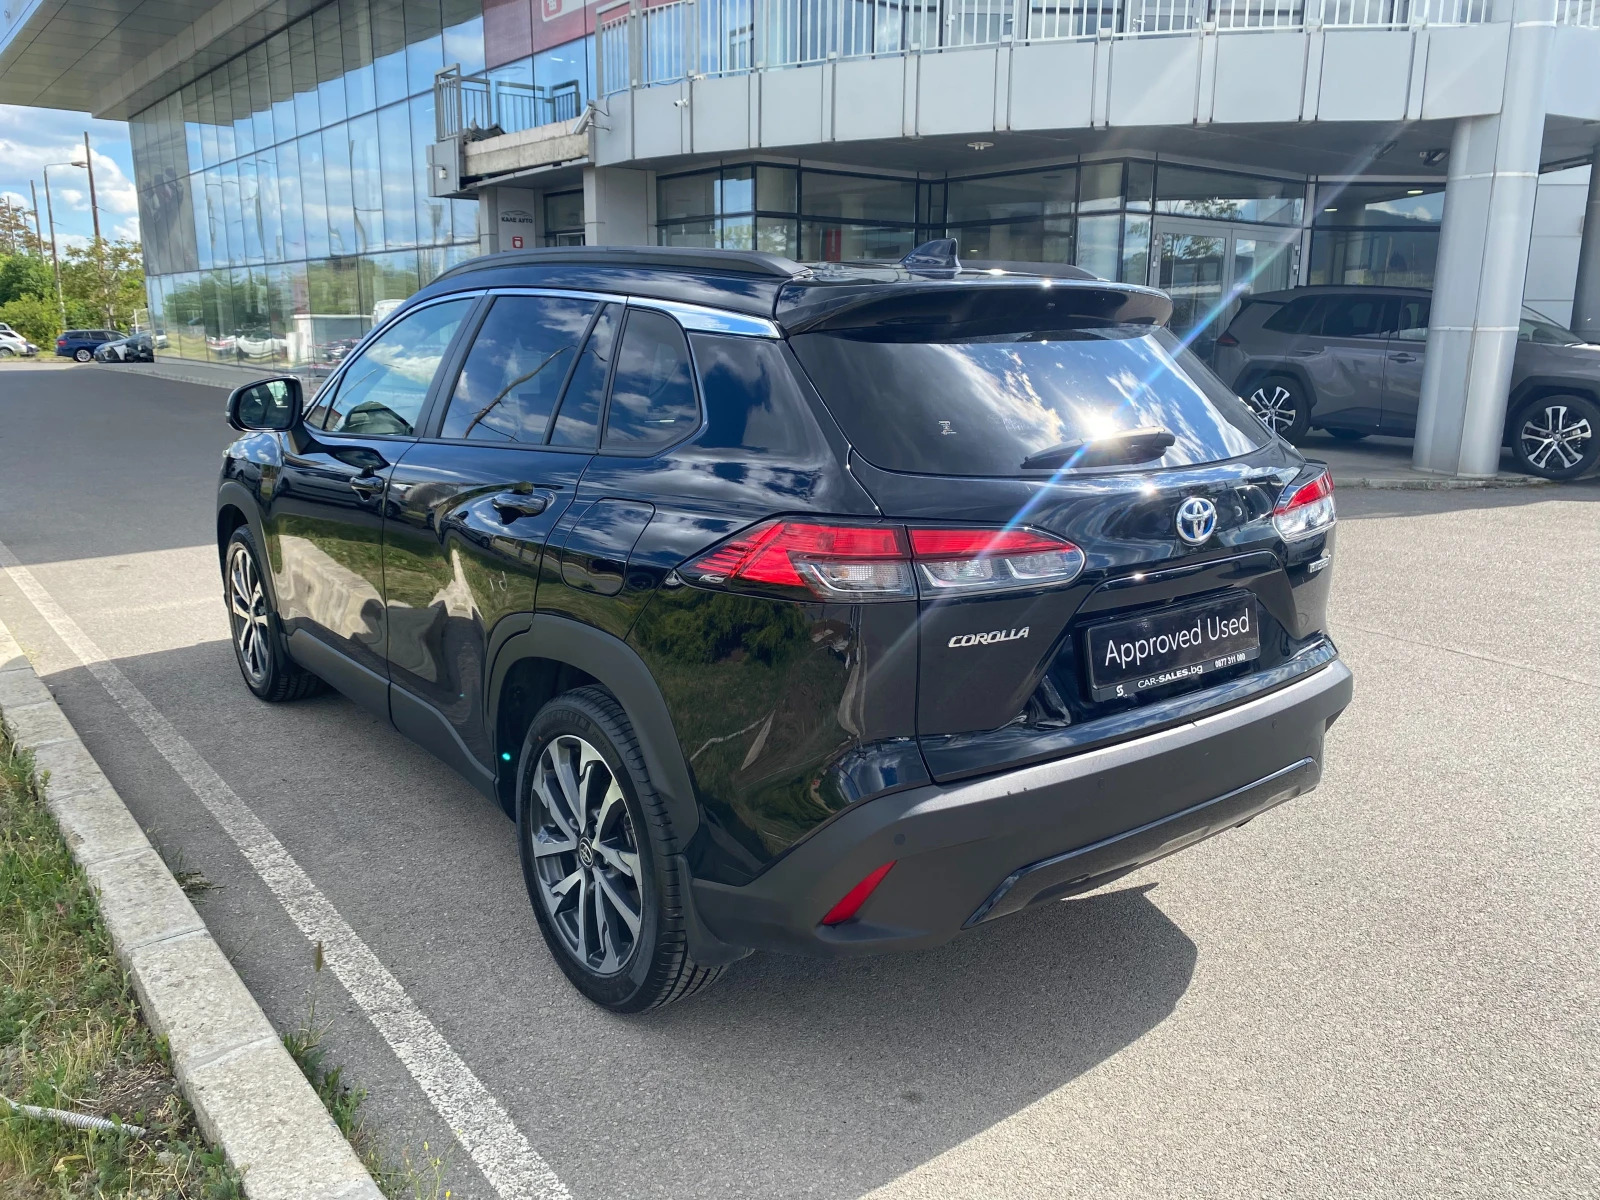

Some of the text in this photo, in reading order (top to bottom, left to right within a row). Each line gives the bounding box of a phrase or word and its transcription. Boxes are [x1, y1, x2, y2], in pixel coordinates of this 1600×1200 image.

[947, 626, 1030, 648] COROLLA
[1105, 607, 1250, 669] Approved Used
[1137, 664, 1203, 689] CAR-SALES.bg
